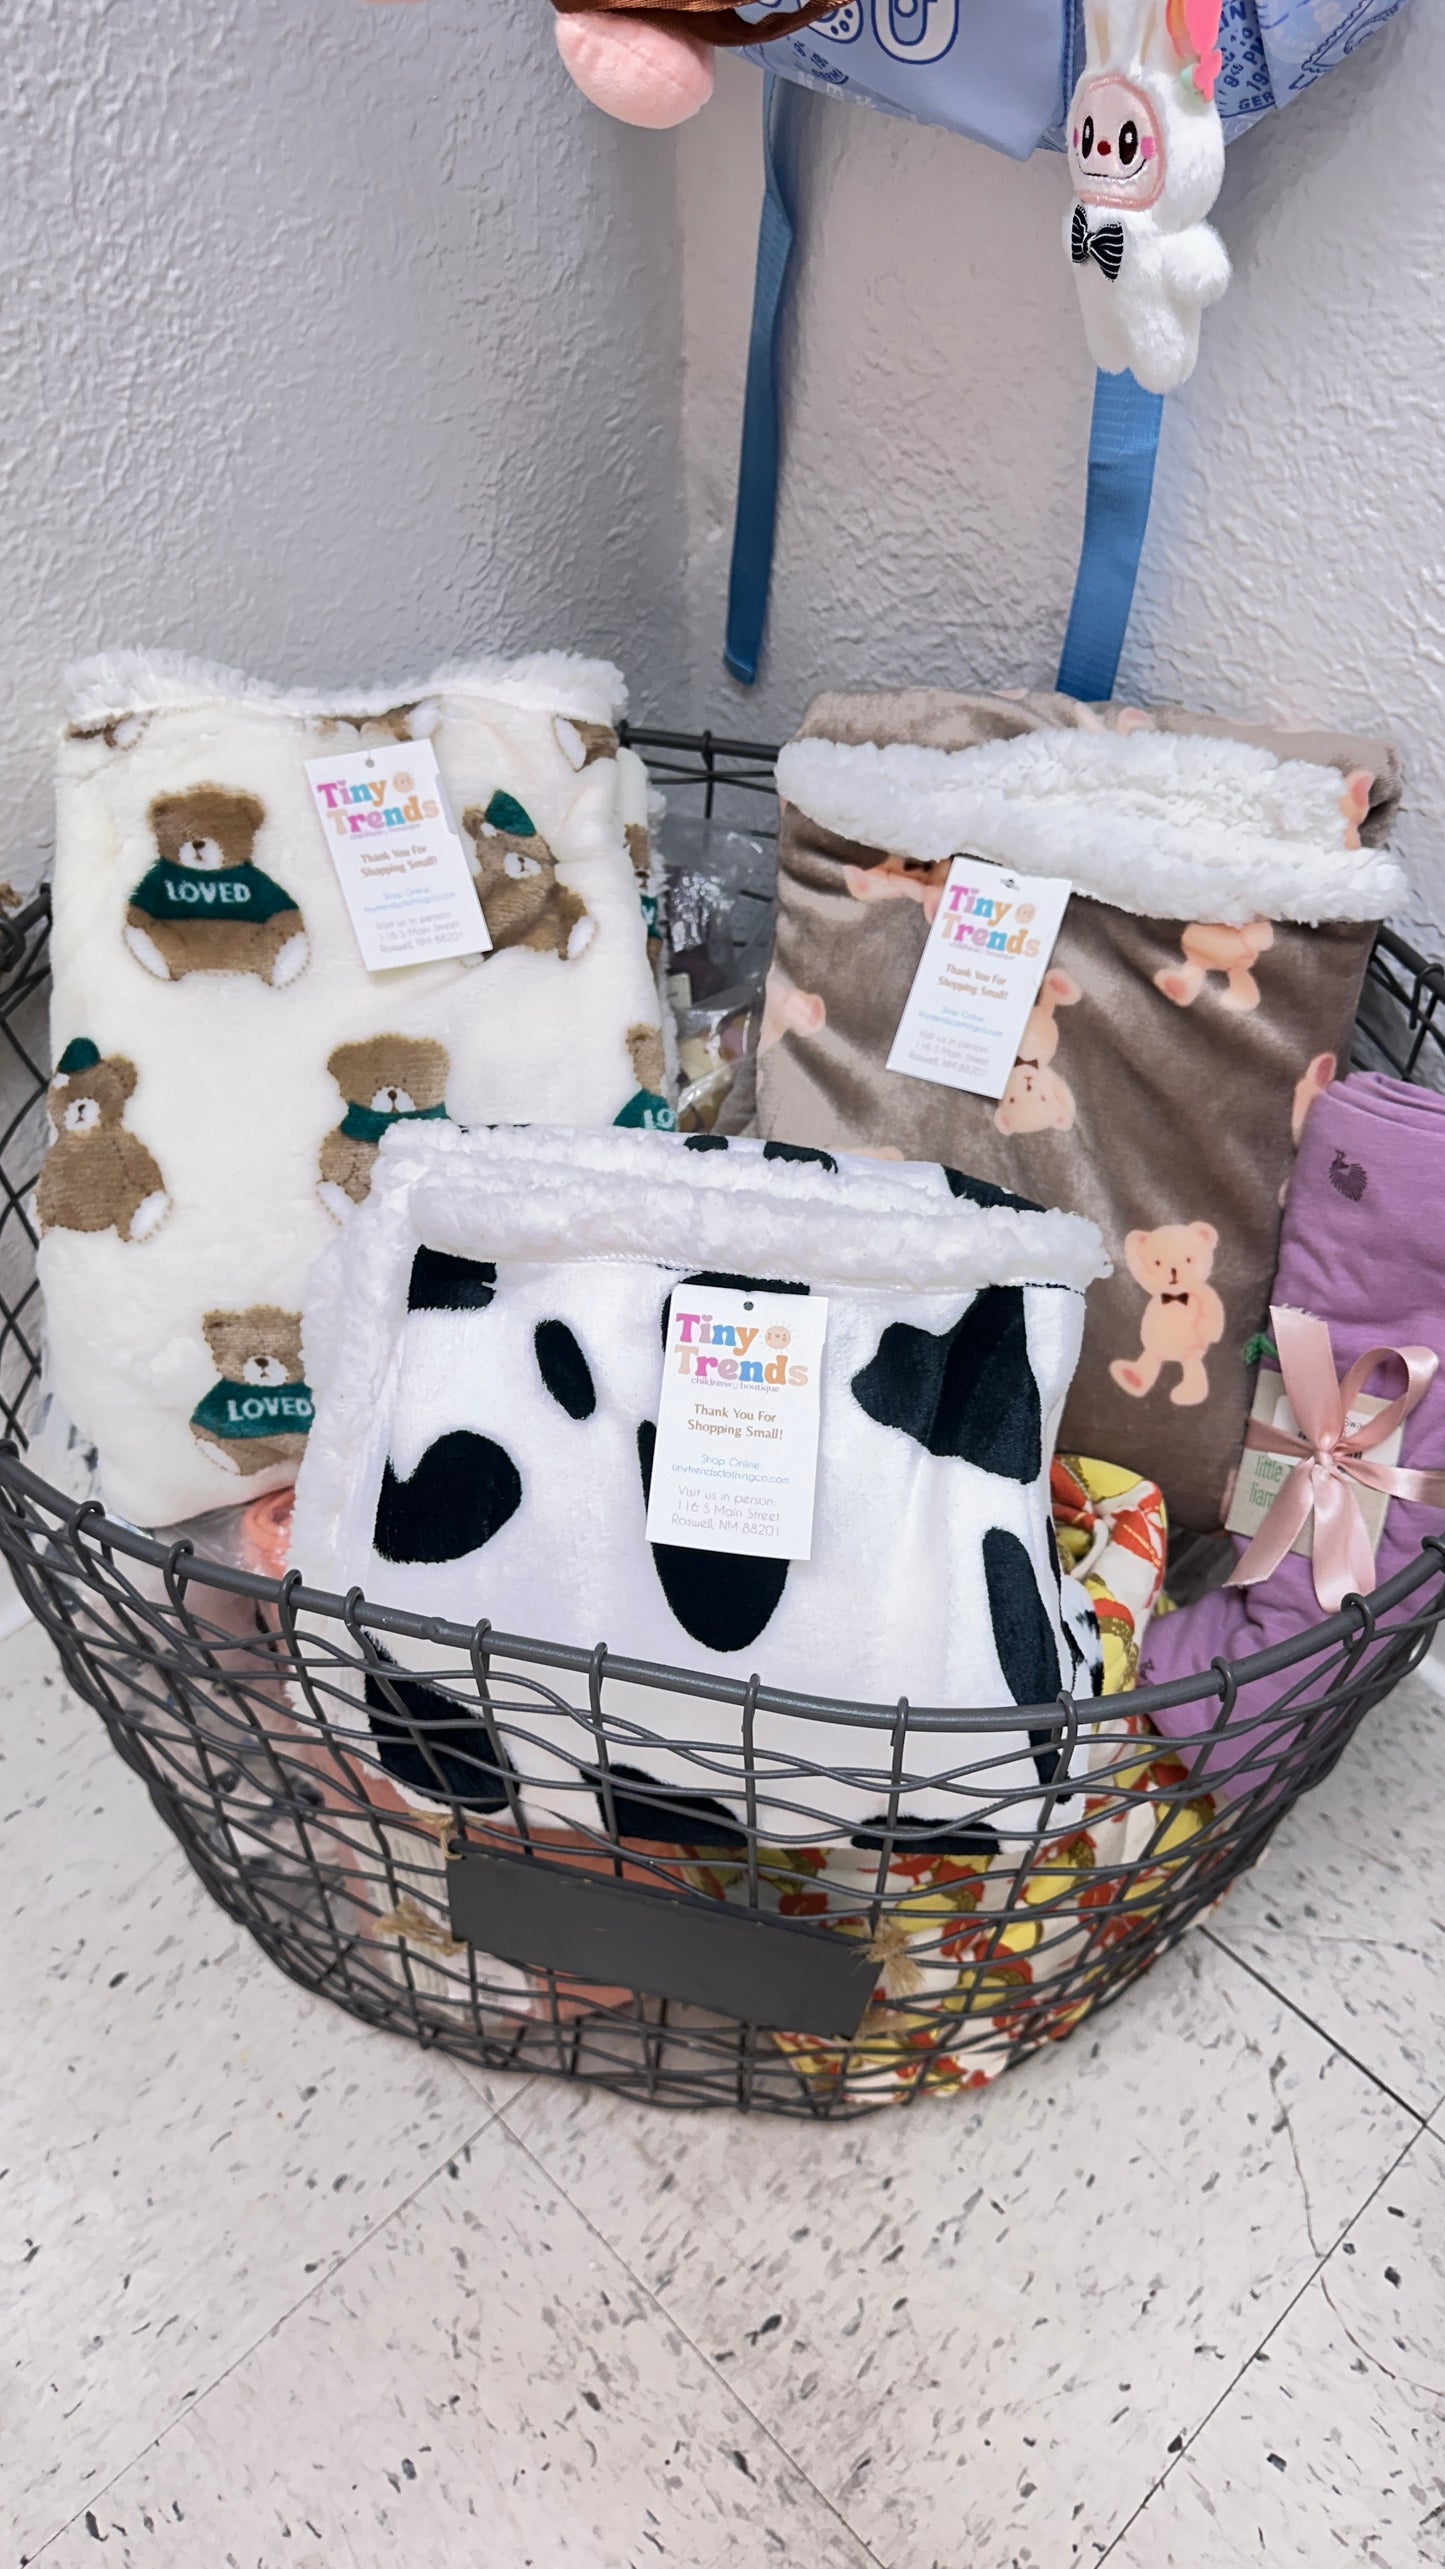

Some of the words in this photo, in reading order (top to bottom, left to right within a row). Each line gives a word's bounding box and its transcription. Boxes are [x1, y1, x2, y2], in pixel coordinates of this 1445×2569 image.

[317, 779, 387, 808] Tiny
[326, 795, 440, 835] Trends
[361, 851, 391, 863] Thank
[392, 849, 410, 858] You
[411, 845, 427, 855] For
[361, 864, 407, 877] Shopping
[164, 880, 251, 904] LOVED
[949, 885, 1012, 927] Tiny
[941, 912, 1041, 958] Trends
[937, 976, 978, 996] Shopping
[945, 963, 971, 978] Thank
[975, 970, 991, 983] You
[992, 974, 1007, 986] For
[675, 1313, 760, 1356] Tiny
[674, 1344, 809, 1387] Trends
[739, 1381, 780, 1394] boutique
[227, 1397, 312, 1421] LOVED
[694, 1403, 729, 1418] Thank
[733, 1407, 754, 1420] You
[758, 1410, 777, 1423] For
[687, 1418, 742, 1439] Shopping
[746, 1425, 783, 1440] Small!
[701, 1453, 726, 1466] Shop
[1254, 1455, 1284, 1483] little
[678, 1485, 701, 1498] Visit
[704, 1491, 717, 1501] us
[720, 1492, 731, 1502] in
[678, 1499, 699, 1513] 116
[703, 1502, 711, 1514] S
[714, 1504, 743, 1518] Main
[747, 1508, 781, 1522] Street
[719, 1519, 738, 1532] NM
[742, 1522, 780, 1537] 88201
